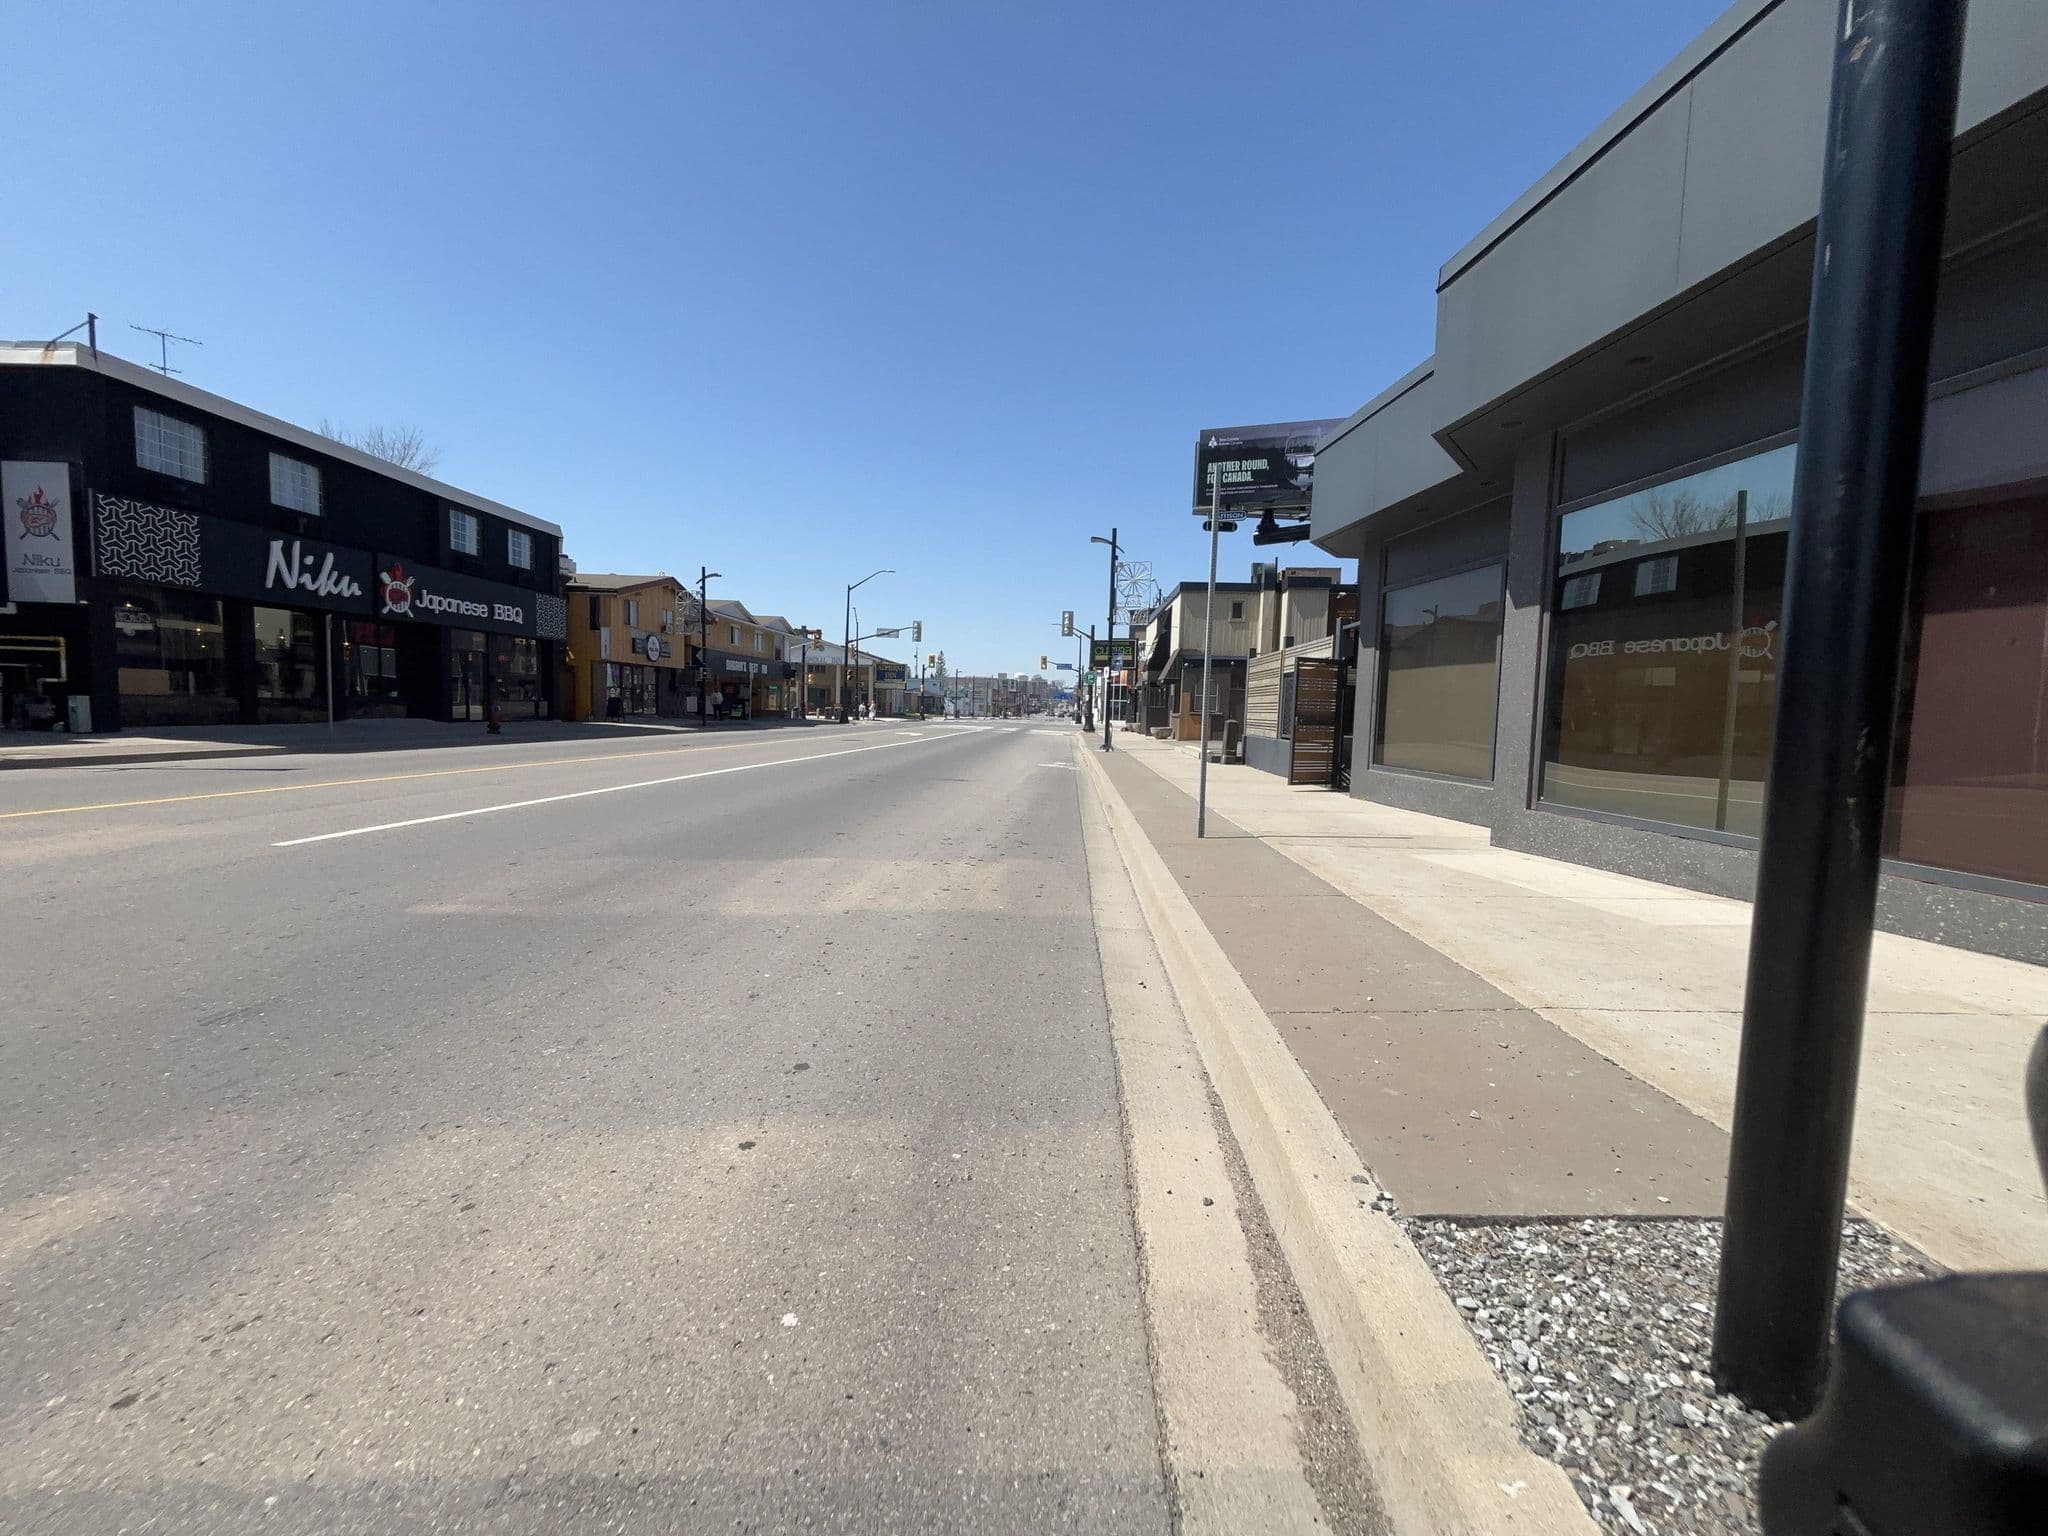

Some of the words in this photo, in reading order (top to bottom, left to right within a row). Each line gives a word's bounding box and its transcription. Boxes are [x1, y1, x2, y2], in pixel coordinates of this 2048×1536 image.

[1242, 459, 1270, 471] ROUND,
[1223, 472, 1254, 483] CANADA.
[265, 539, 362, 598] Niku
[415, 589, 488, 618] Japanese
[493, 603, 525, 625] BBQ
